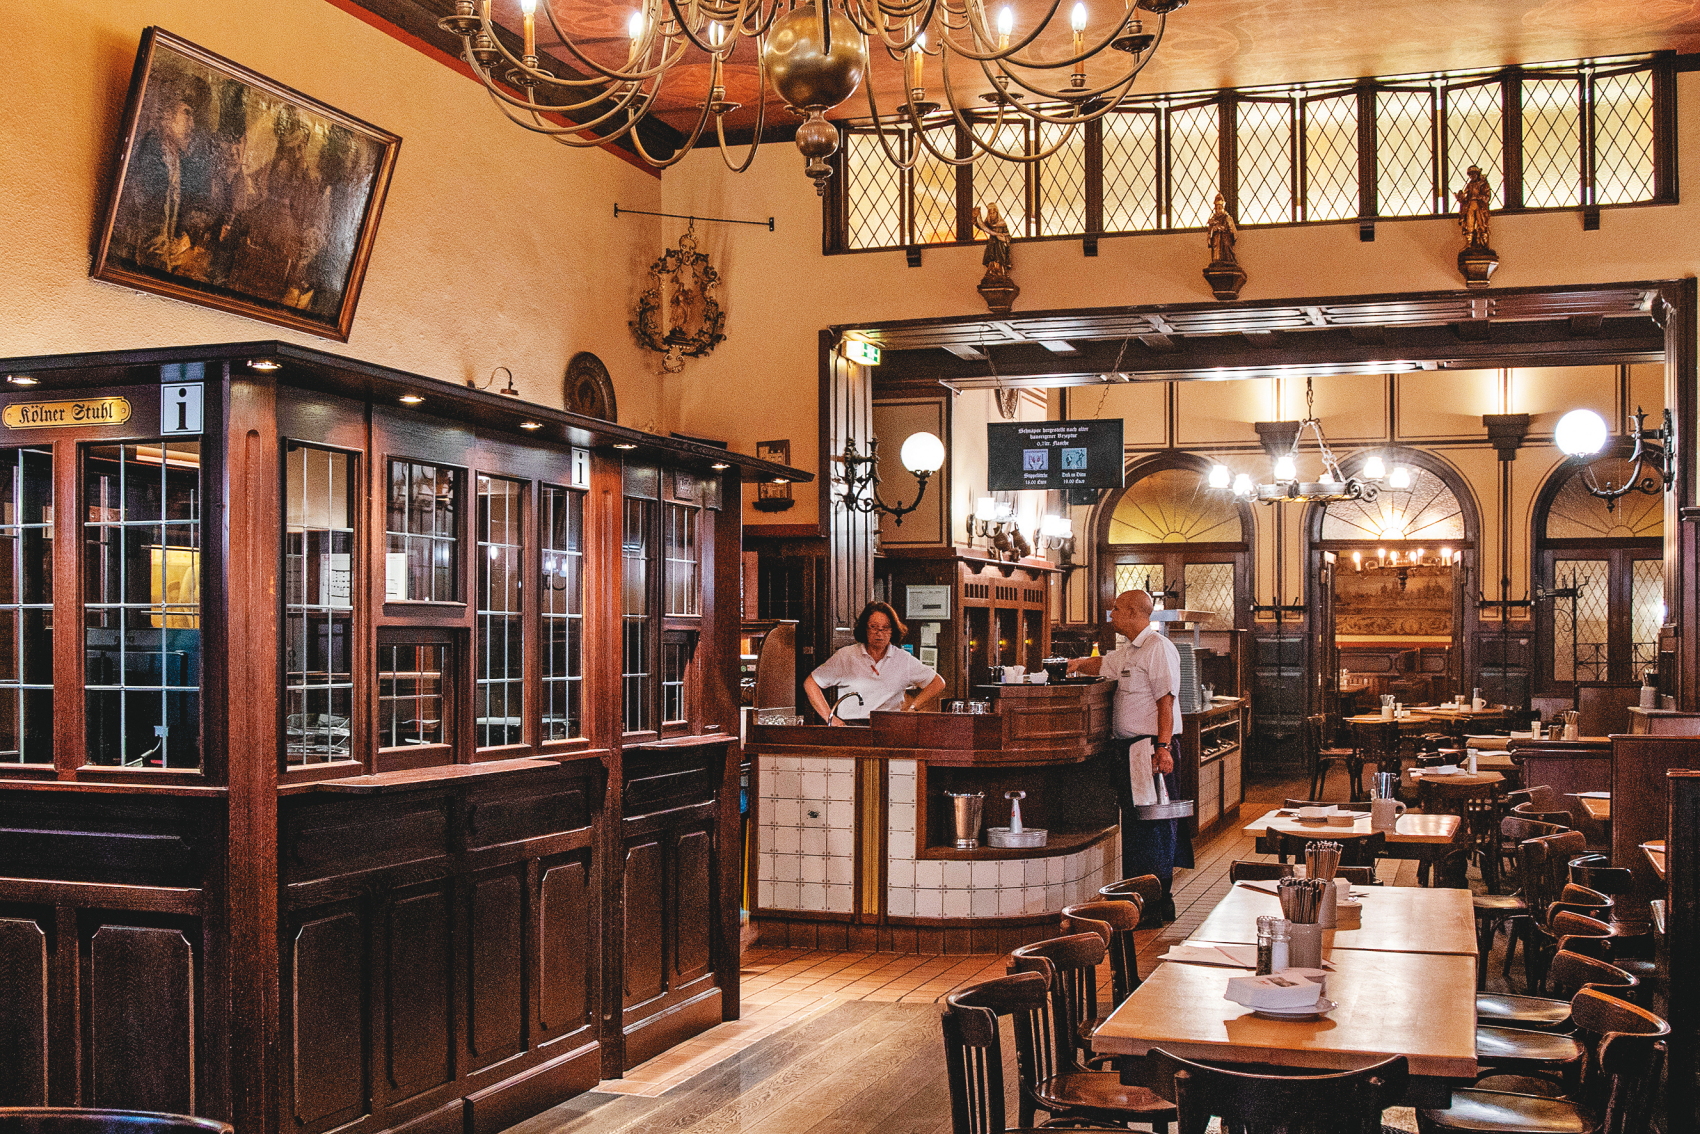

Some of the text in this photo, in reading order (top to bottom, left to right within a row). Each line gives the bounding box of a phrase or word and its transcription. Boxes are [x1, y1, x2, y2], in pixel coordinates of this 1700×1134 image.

[19, 402, 114, 424] Kölner Stuhl
[176, 387, 189, 430] i
